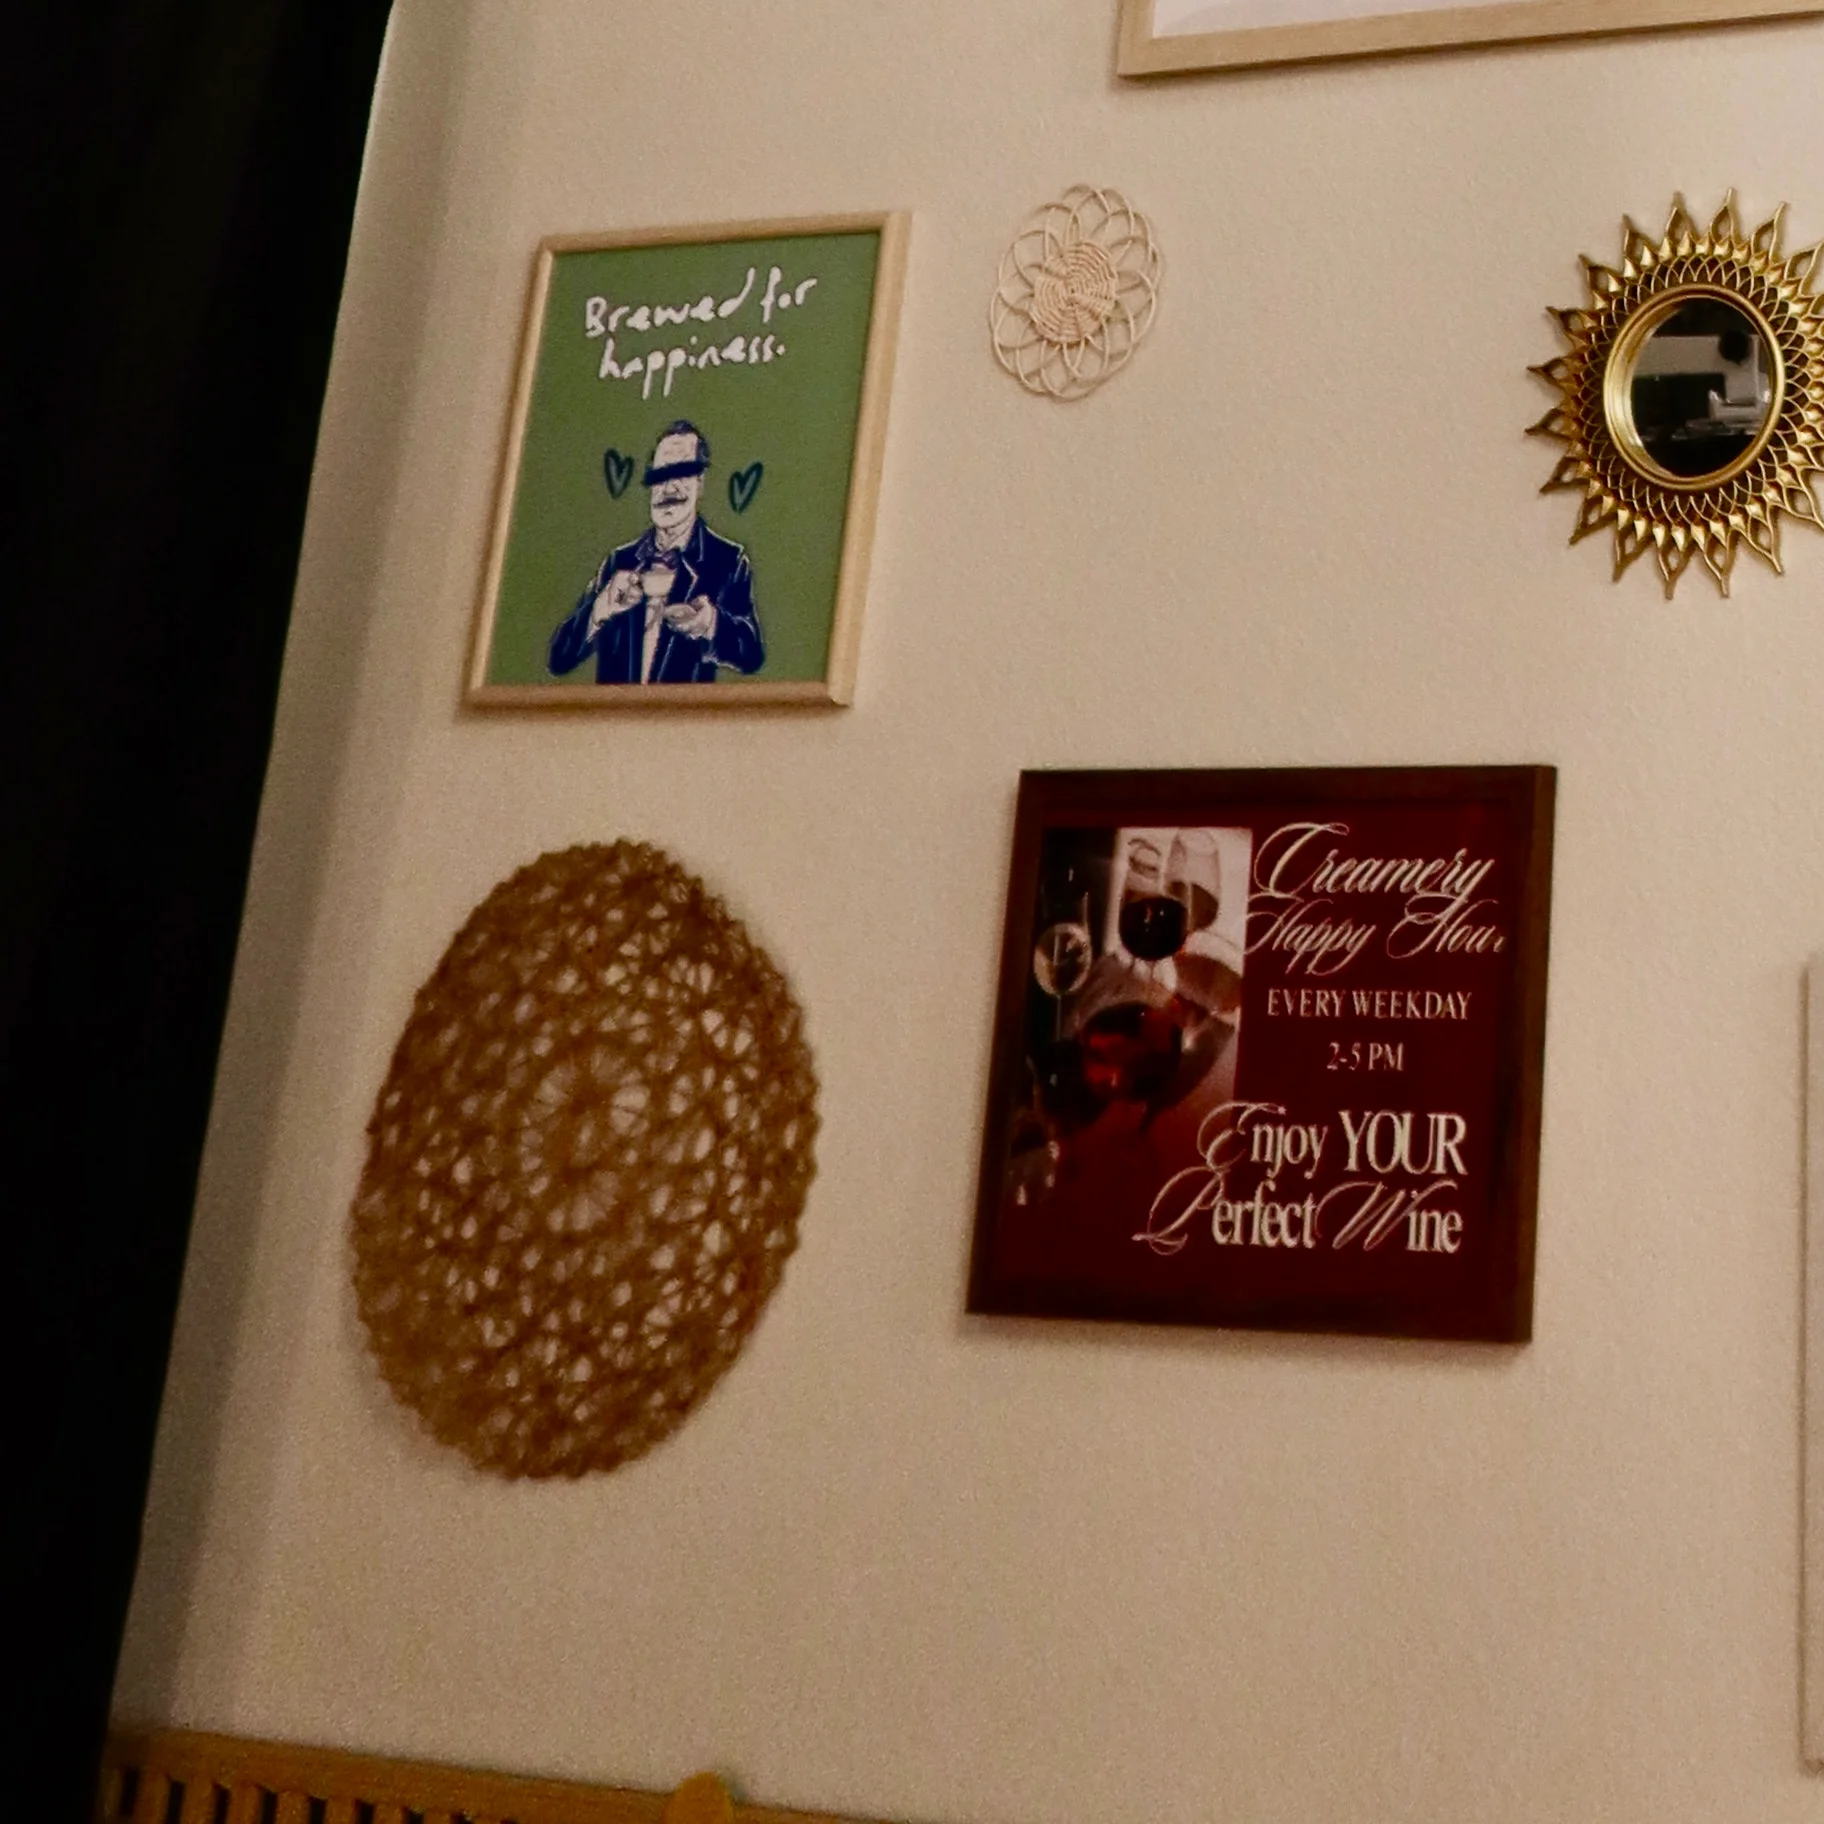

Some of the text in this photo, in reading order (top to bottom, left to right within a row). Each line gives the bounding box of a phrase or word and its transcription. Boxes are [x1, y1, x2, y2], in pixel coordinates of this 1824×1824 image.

[585, 266, 818, 338] Brewed for
[1253, 822, 1495, 901] Creamery
[1244, 894, 1505, 975] Happy Hour
[1266, 989, 1472, 1020] EVERY WEEKDAY
[1327, 1042, 1404, 1072] 2-5 PM
[1198, 1101, 1468, 1180] Enjoy YOUR
[1131, 1165, 1463, 1256] Perfect Wine
